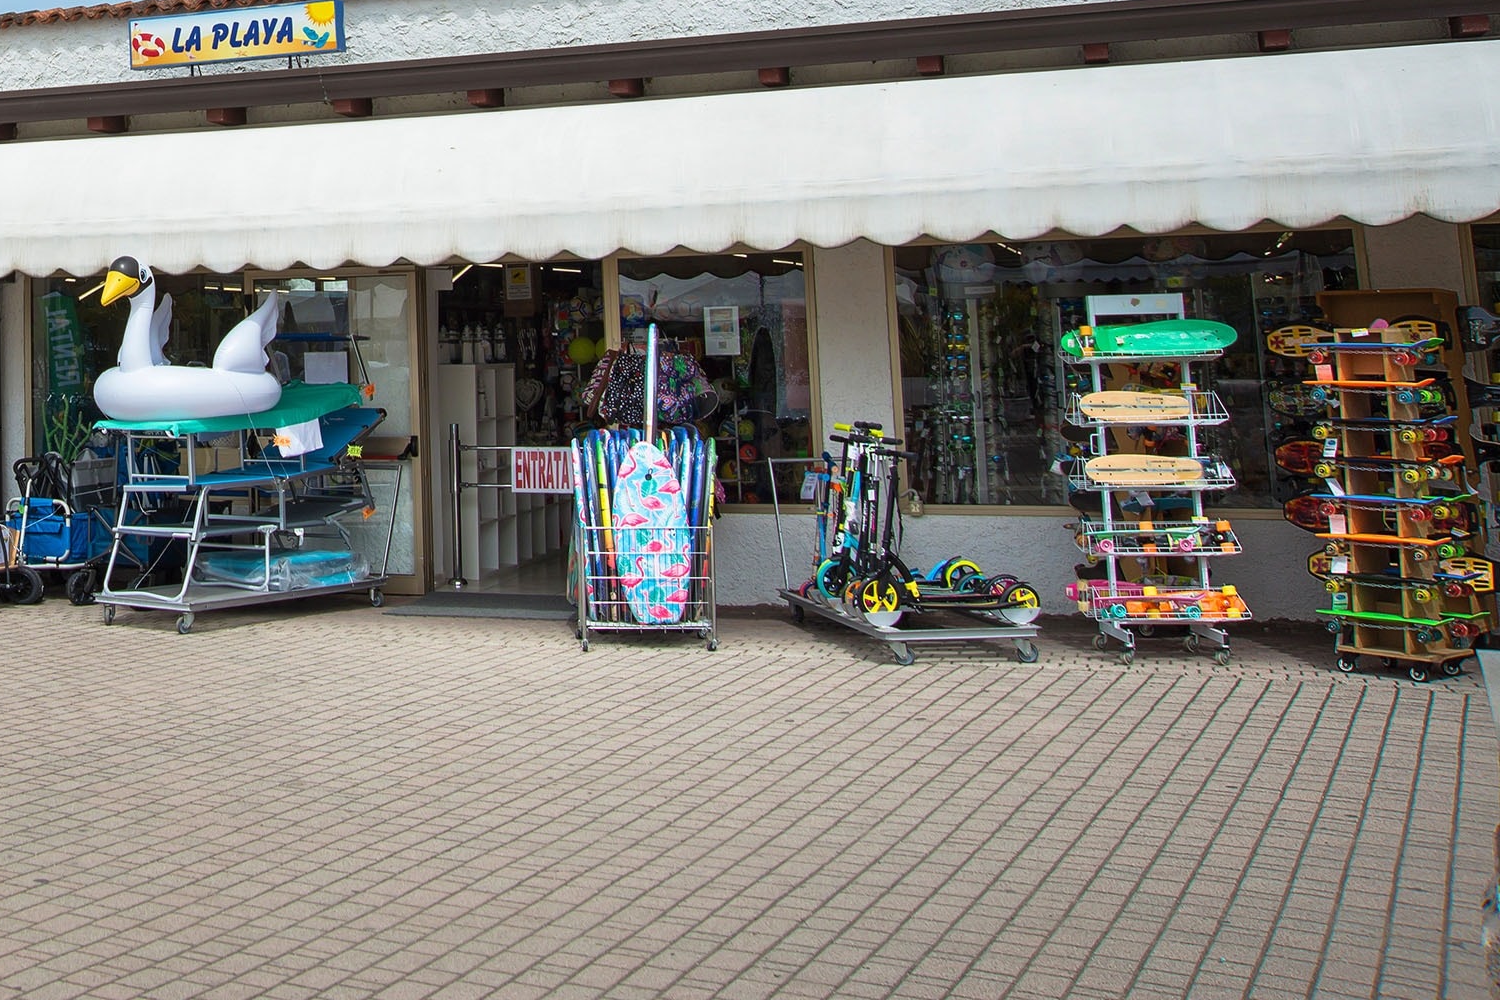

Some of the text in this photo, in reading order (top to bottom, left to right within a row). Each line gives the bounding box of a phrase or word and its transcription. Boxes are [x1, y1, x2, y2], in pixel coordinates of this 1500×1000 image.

[171, 17, 294, 54] LA PLAYA
[515, 451, 570, 489] ENTRATA
